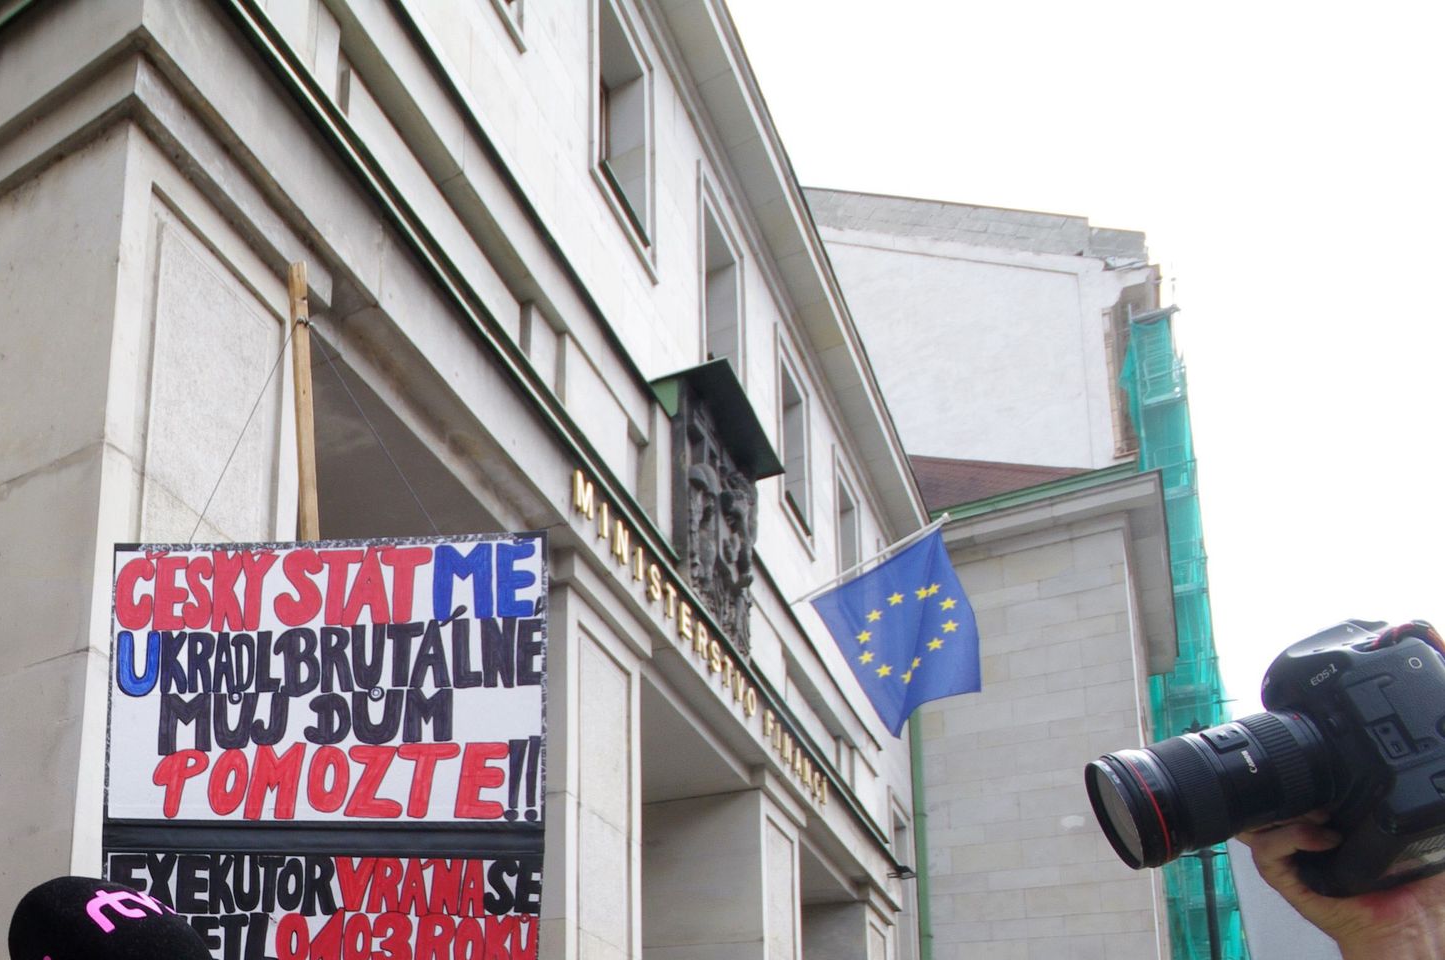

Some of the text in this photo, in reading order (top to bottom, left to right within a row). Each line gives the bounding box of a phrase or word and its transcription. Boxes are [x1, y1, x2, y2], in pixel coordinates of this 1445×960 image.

[115, 549, 280, 632] ČESKÝ
[573, 469, 757, 717] MINISTERSTVO
[116, 630, 282, 697] UKRADL
[158, 686, 453, 755] MŮJ DŮM
[109, 854, 540, 917] EXEKUTOR VRÁNA SE
